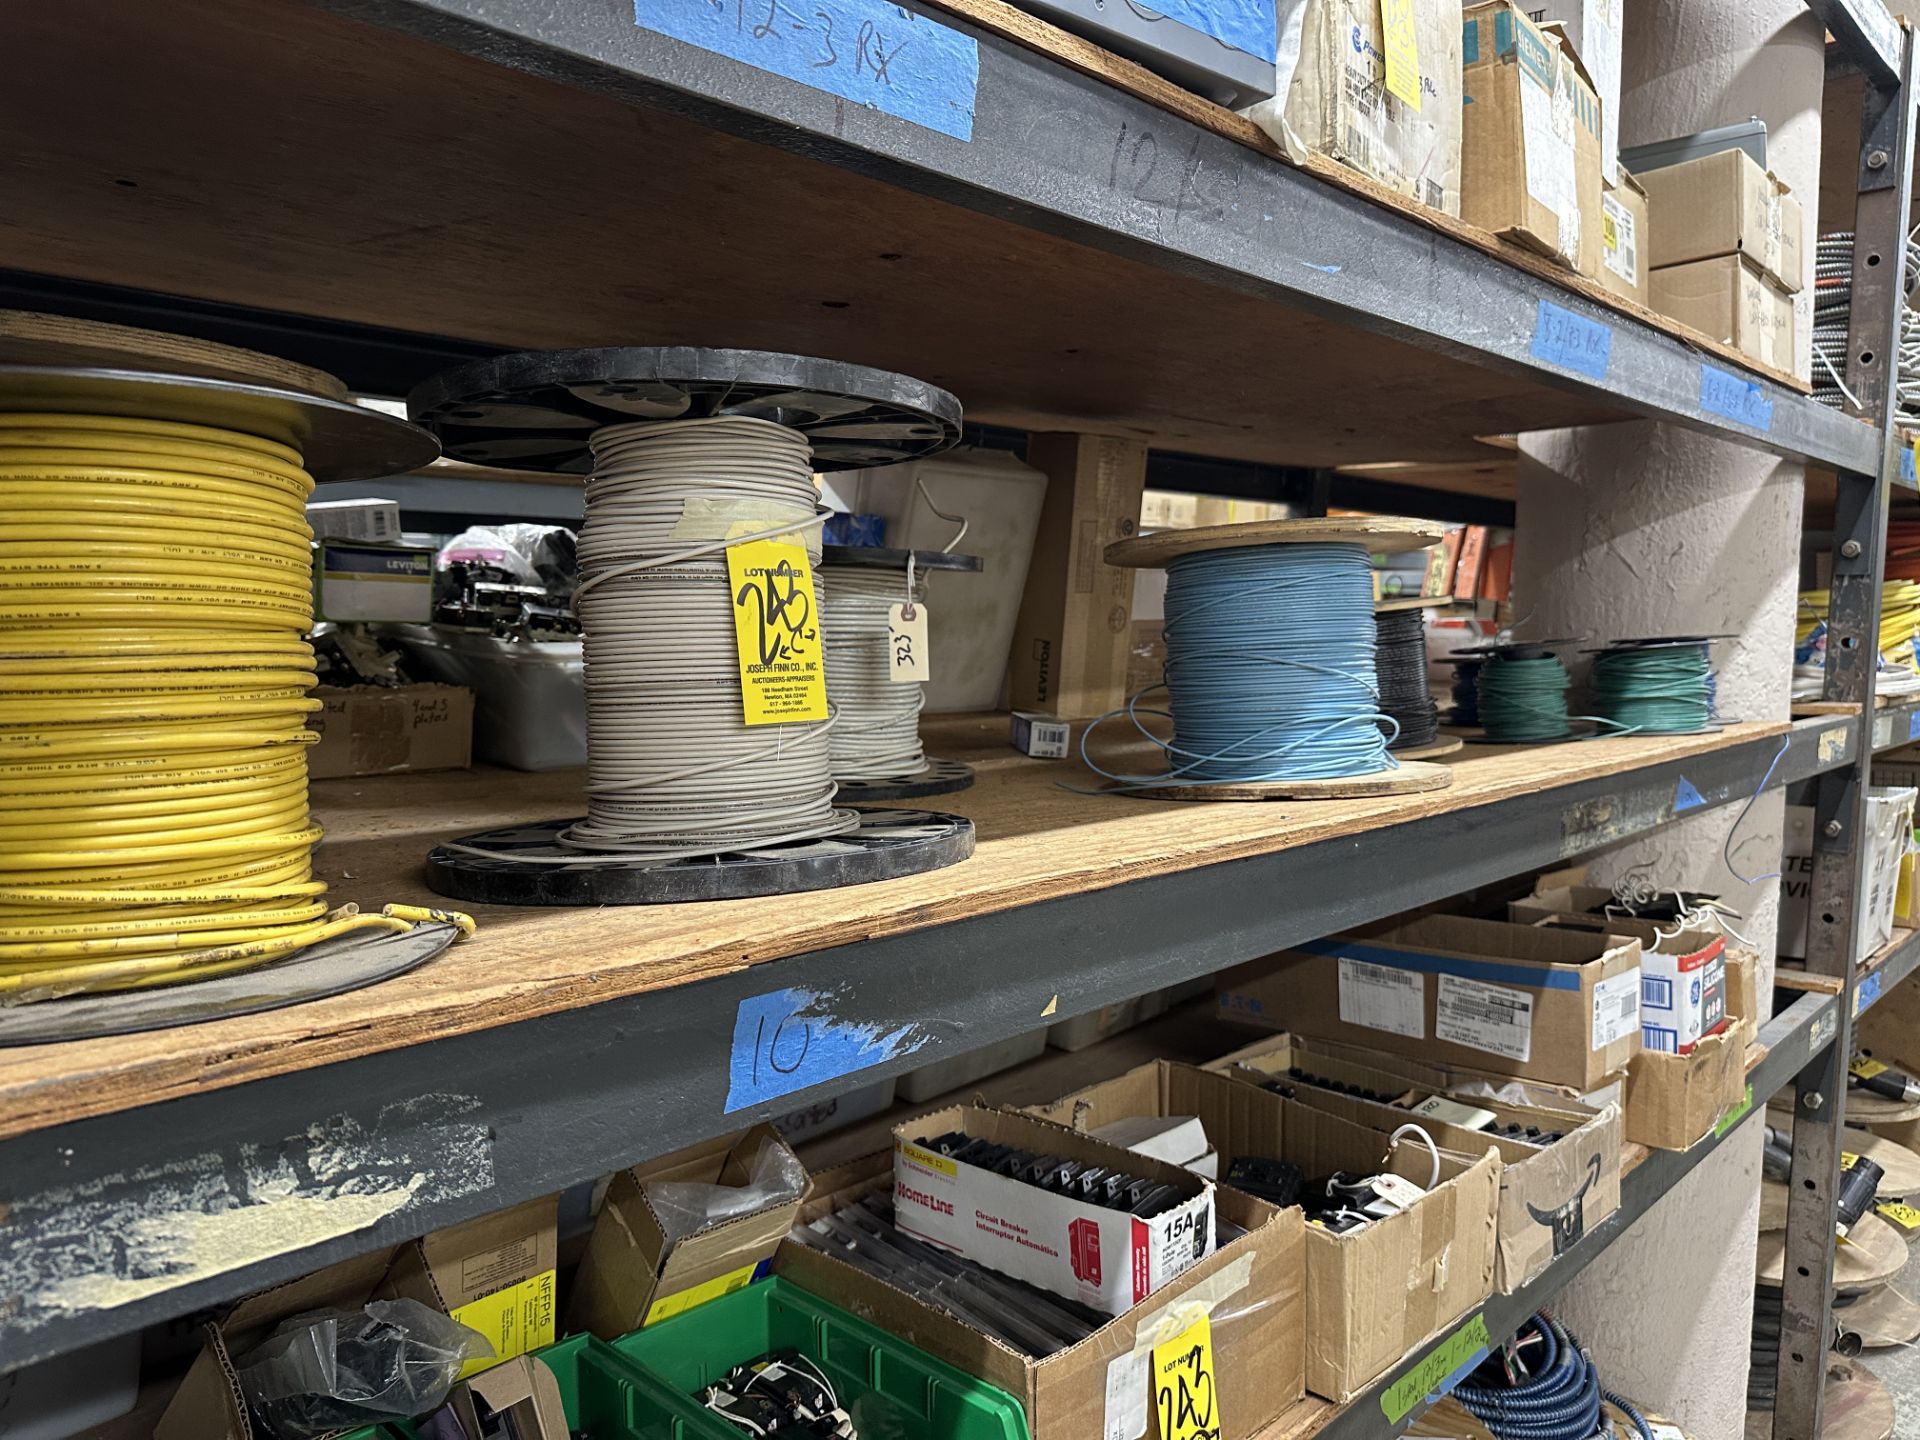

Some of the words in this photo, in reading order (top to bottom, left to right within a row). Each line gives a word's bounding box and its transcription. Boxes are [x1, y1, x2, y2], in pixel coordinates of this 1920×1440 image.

[386, 559, 429, 571] LEVITON
[744, 568, 765, 577] LOT
[746, 663, 773, 674] JOSEPH
[774, 663, 790, 673] FINN
[806, 661, 819, 672] INC.
[1037, 640, 1051, 703] LEVITON
[752, 1013, 810, 1086] 10
[975, 1209, 999, 1225] Circuit
[1000, 1218, 1029, 1236] Breaker
[975, 1220, 1015, 1242] Interruptor
[1164, 1211, 1194, 1243] 15A
[539, 1275, 551, 1328] NFFP15
[1164, 1360, 1178, 1374] LOT
